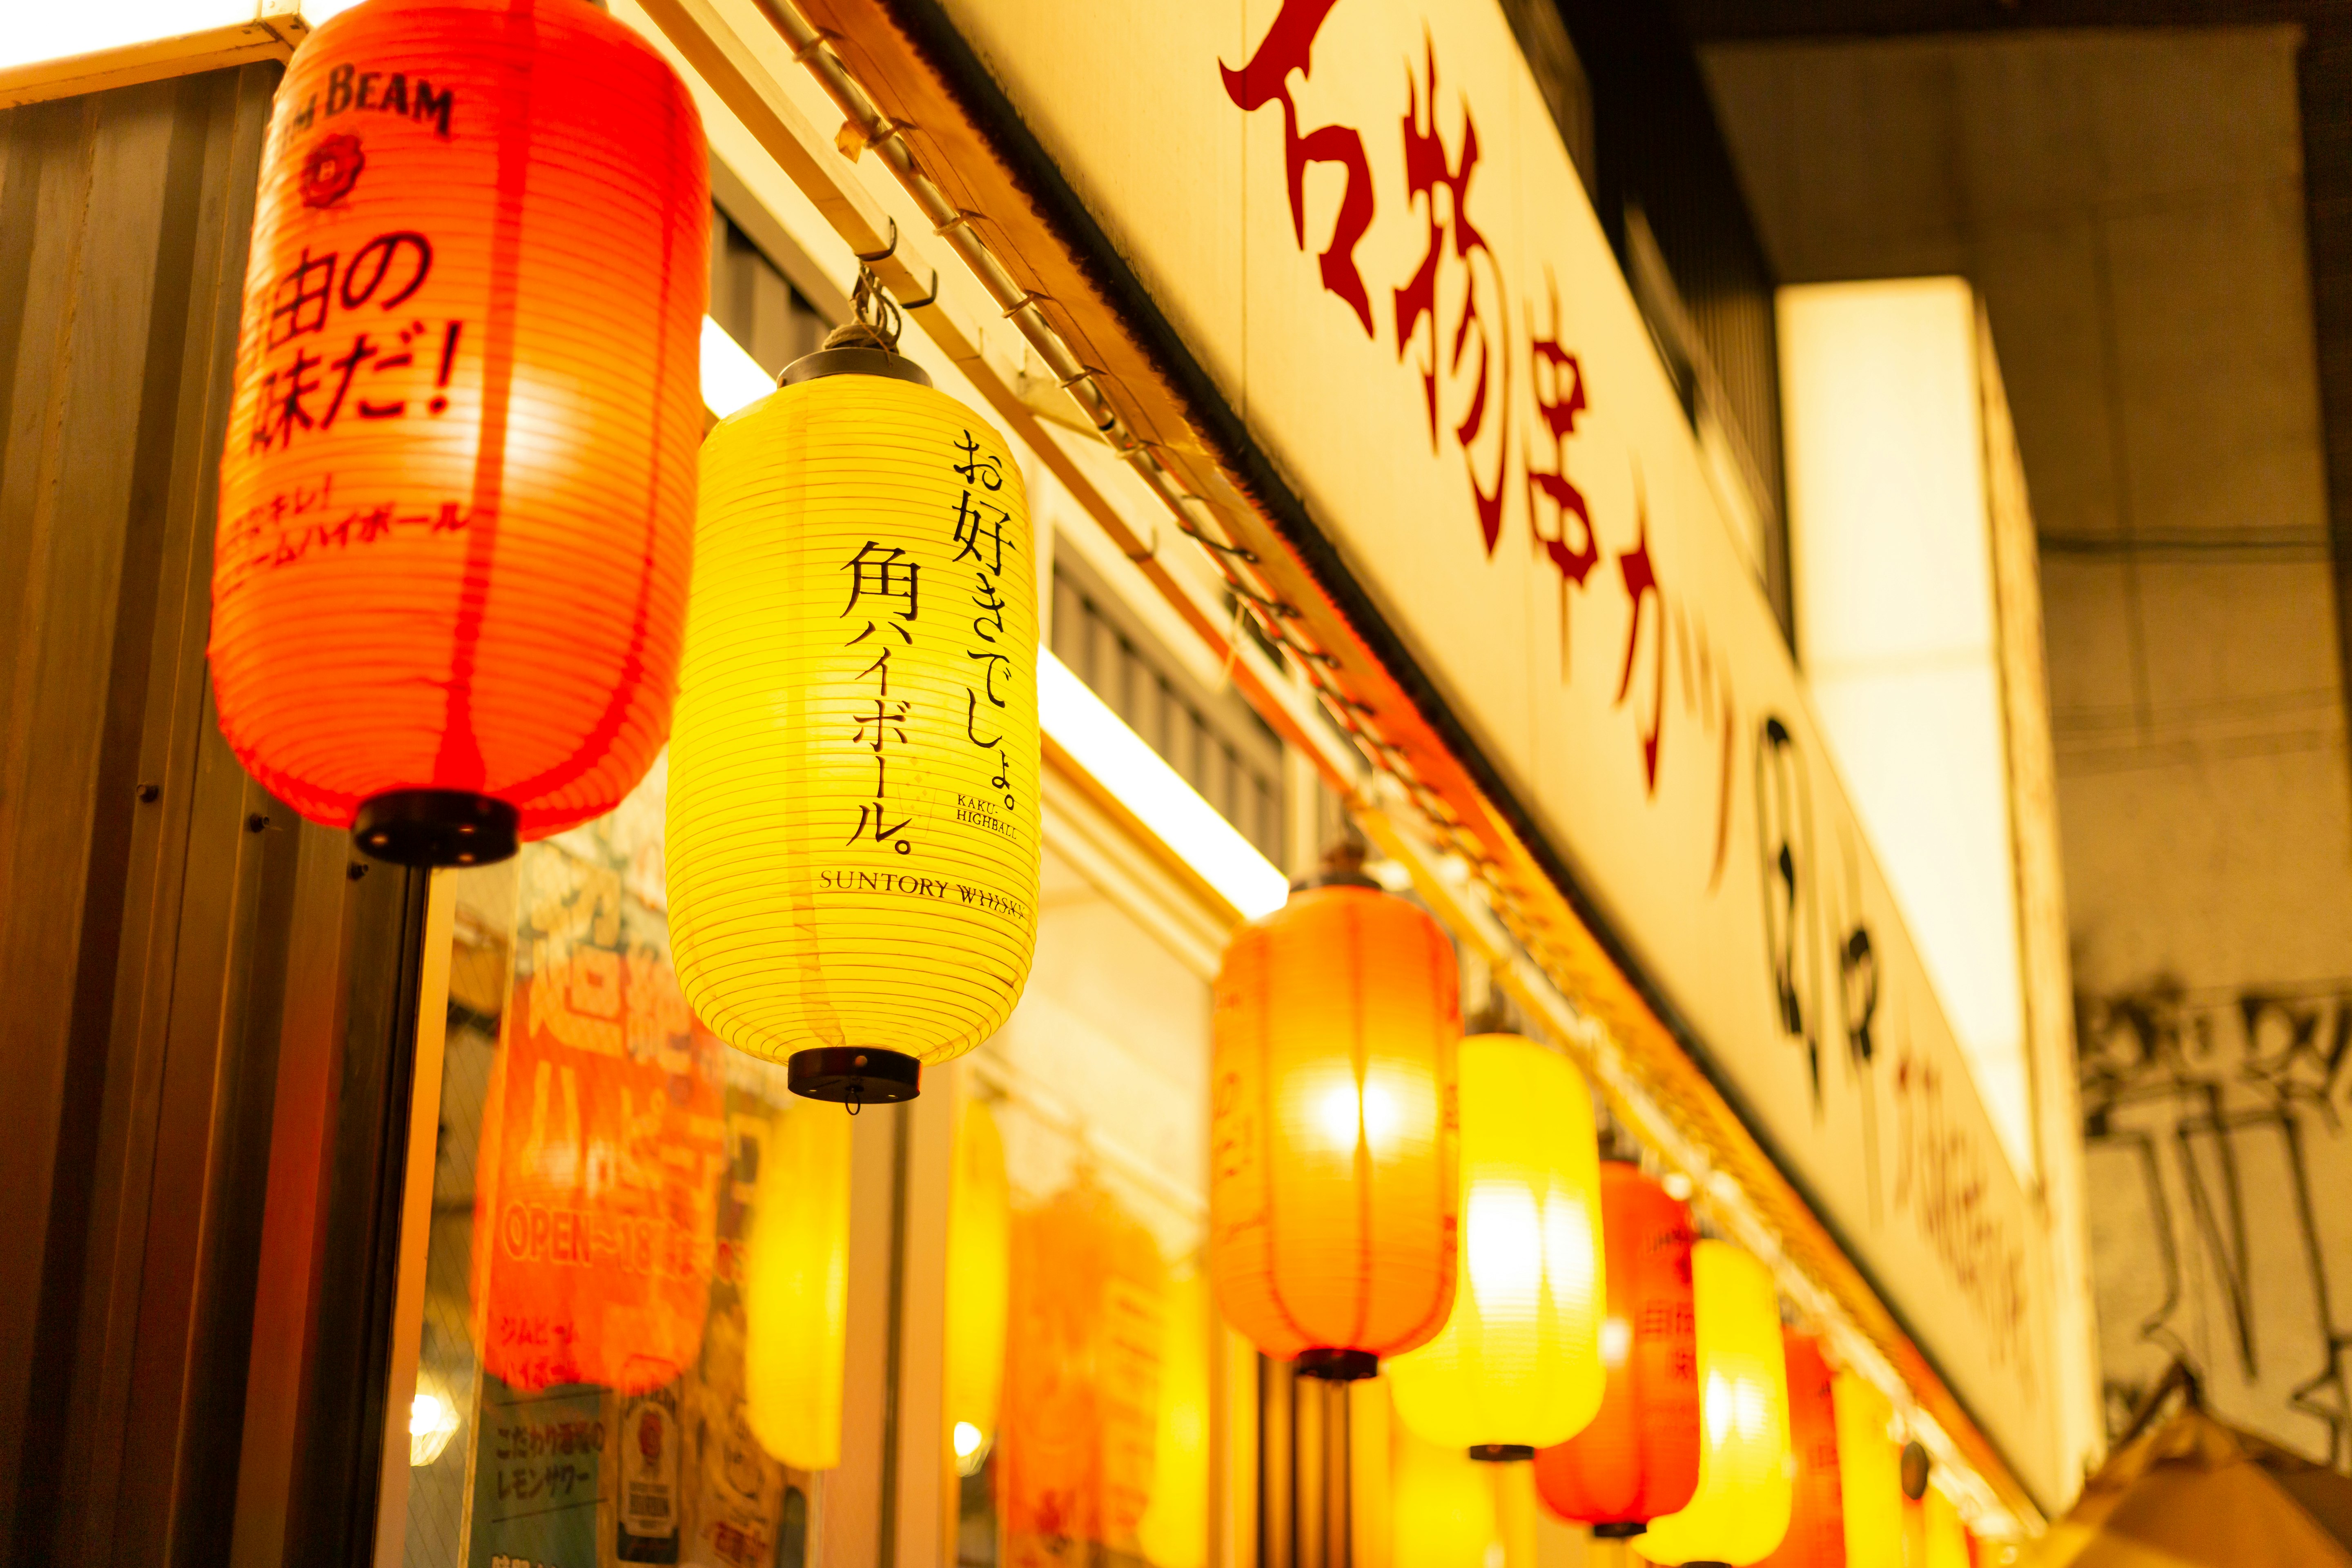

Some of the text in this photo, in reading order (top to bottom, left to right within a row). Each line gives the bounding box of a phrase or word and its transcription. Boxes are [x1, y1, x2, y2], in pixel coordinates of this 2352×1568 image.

[325, 62, 452, 138] BEAM
[263, 230, 433, 352] 由の
[953, 430, 1016, 811] お好きでしょ。
[840, 541, 921, 855] 角ハイボール。
[957, 809, 1017, 840] HIGHBALL
[958, 794, 998, 814] KAKU-
[820, 870, 1025, 919] SUNTORY WHISKY
[497, 1464, 590, 1500] レモンサワー
